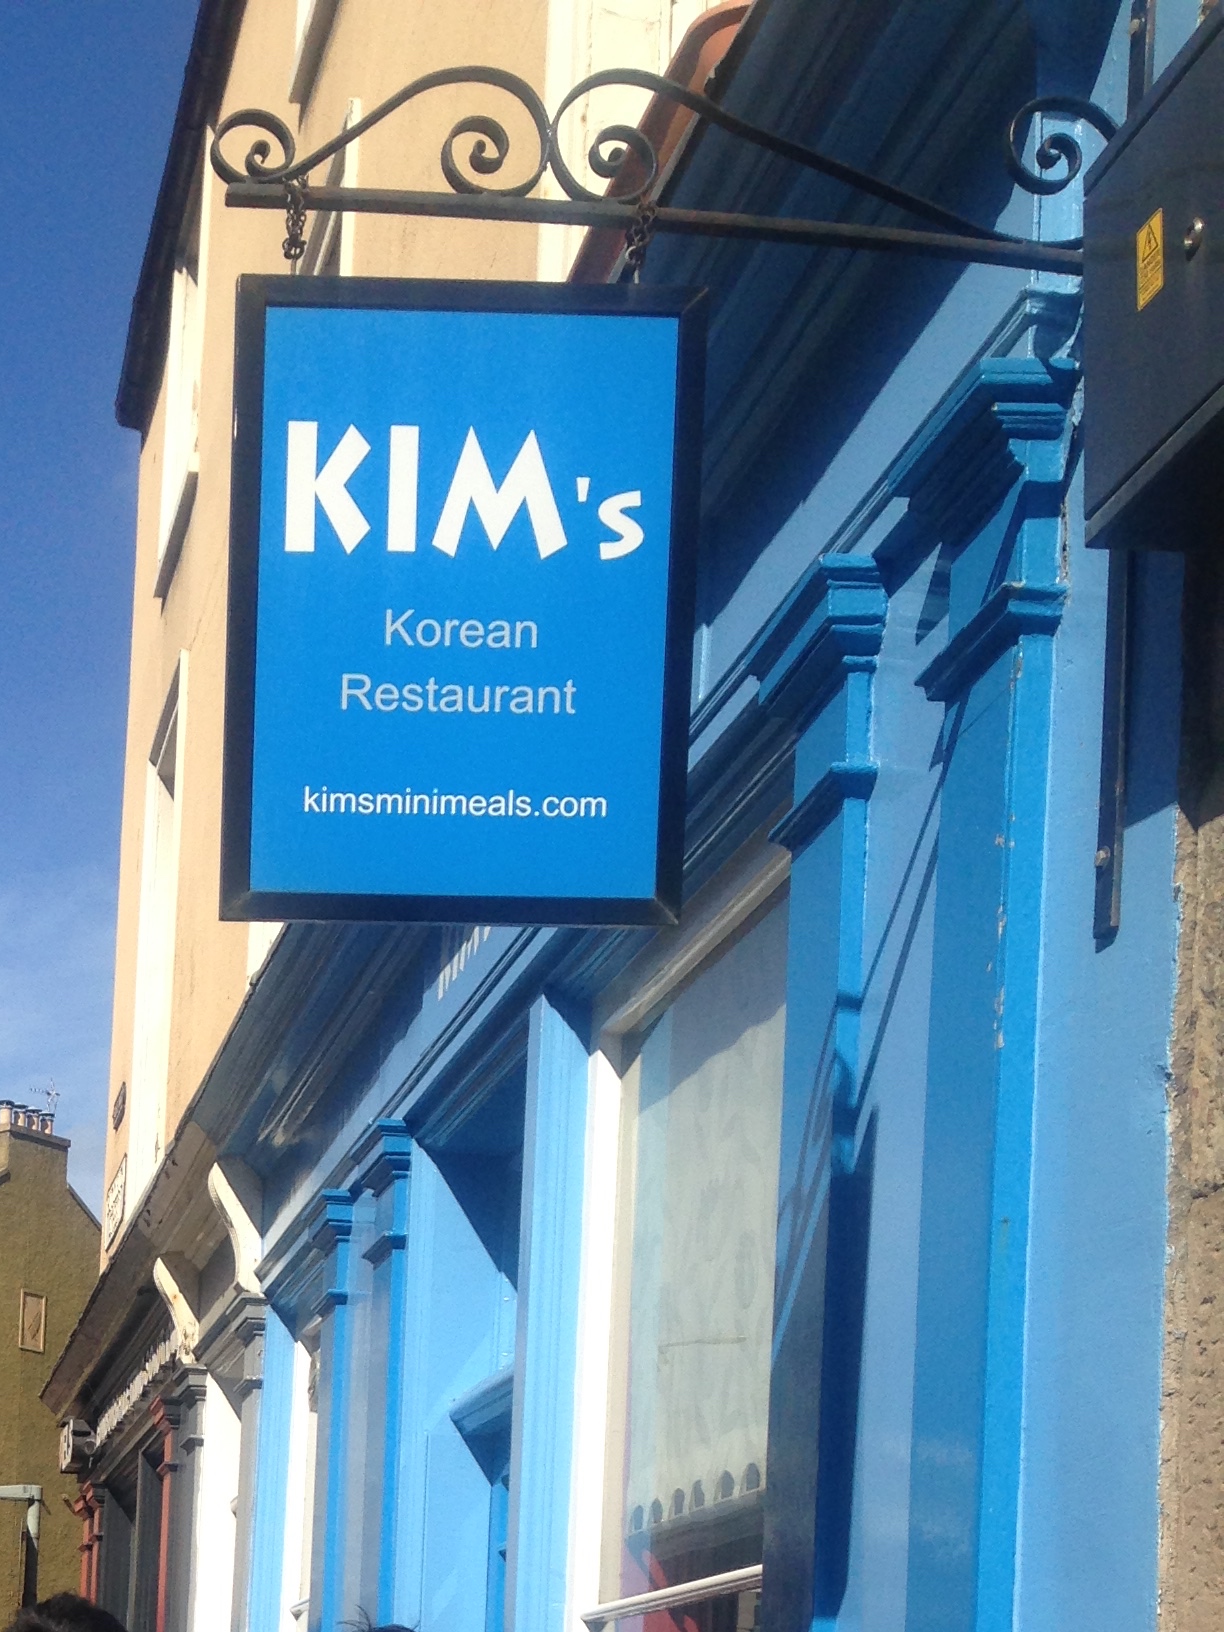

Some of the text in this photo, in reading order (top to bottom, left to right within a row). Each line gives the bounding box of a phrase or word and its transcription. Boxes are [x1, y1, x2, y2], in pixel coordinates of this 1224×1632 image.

[283, 420, 645, 561] KIM's
[384, 607, 539, 650] Korean
[340, 672, 578, 715] Restaurant
[302, 784, 608, 819] kimsminimeals.com
